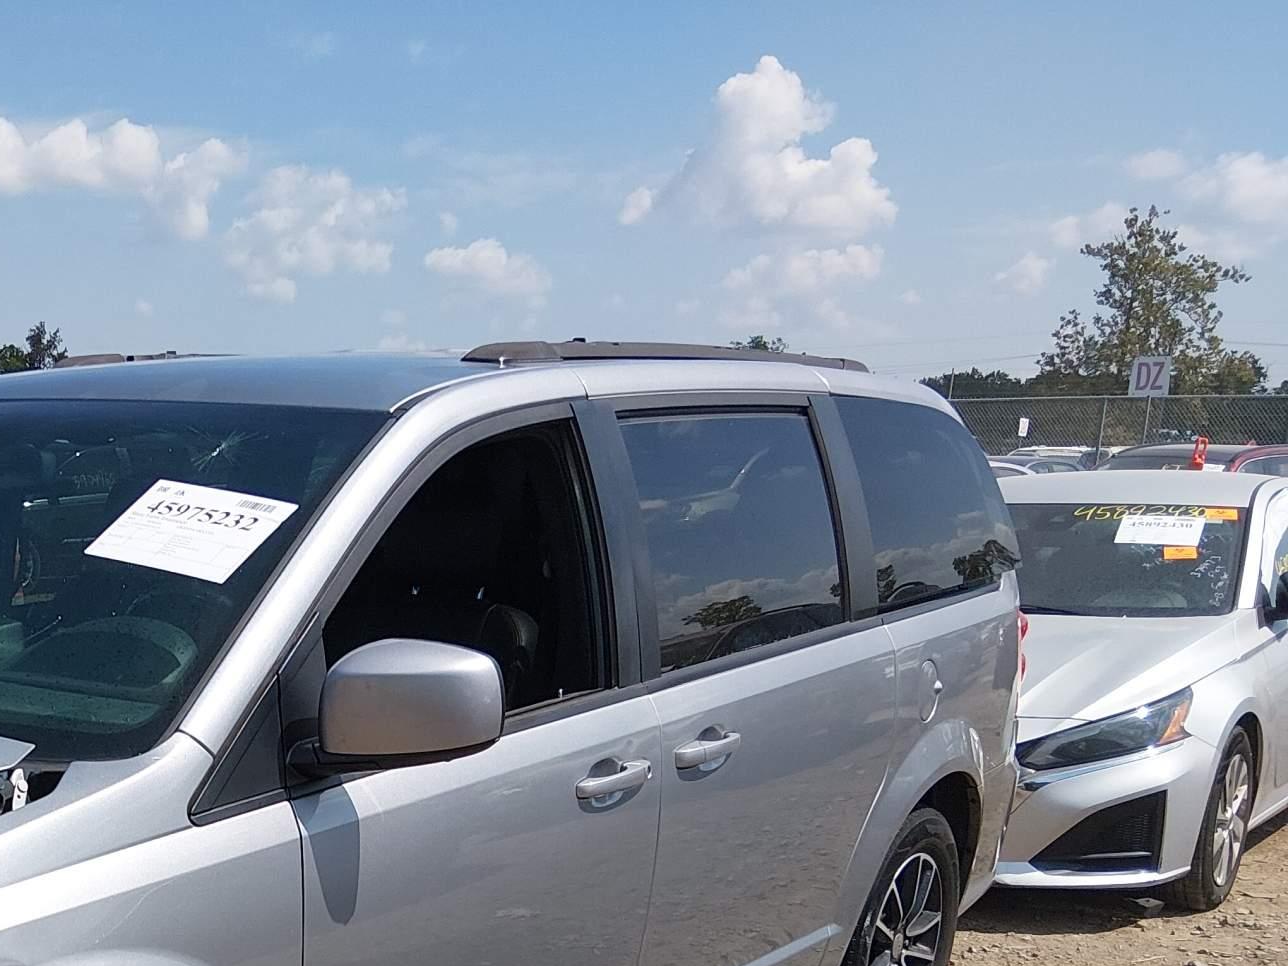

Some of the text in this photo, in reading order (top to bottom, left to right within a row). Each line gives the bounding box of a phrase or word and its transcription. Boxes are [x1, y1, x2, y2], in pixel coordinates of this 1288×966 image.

[1135, 361, 1165, 390] DZ
[147, 500, 259, 531] 45975232
[1073, 505, 1208, 521] 45892430
